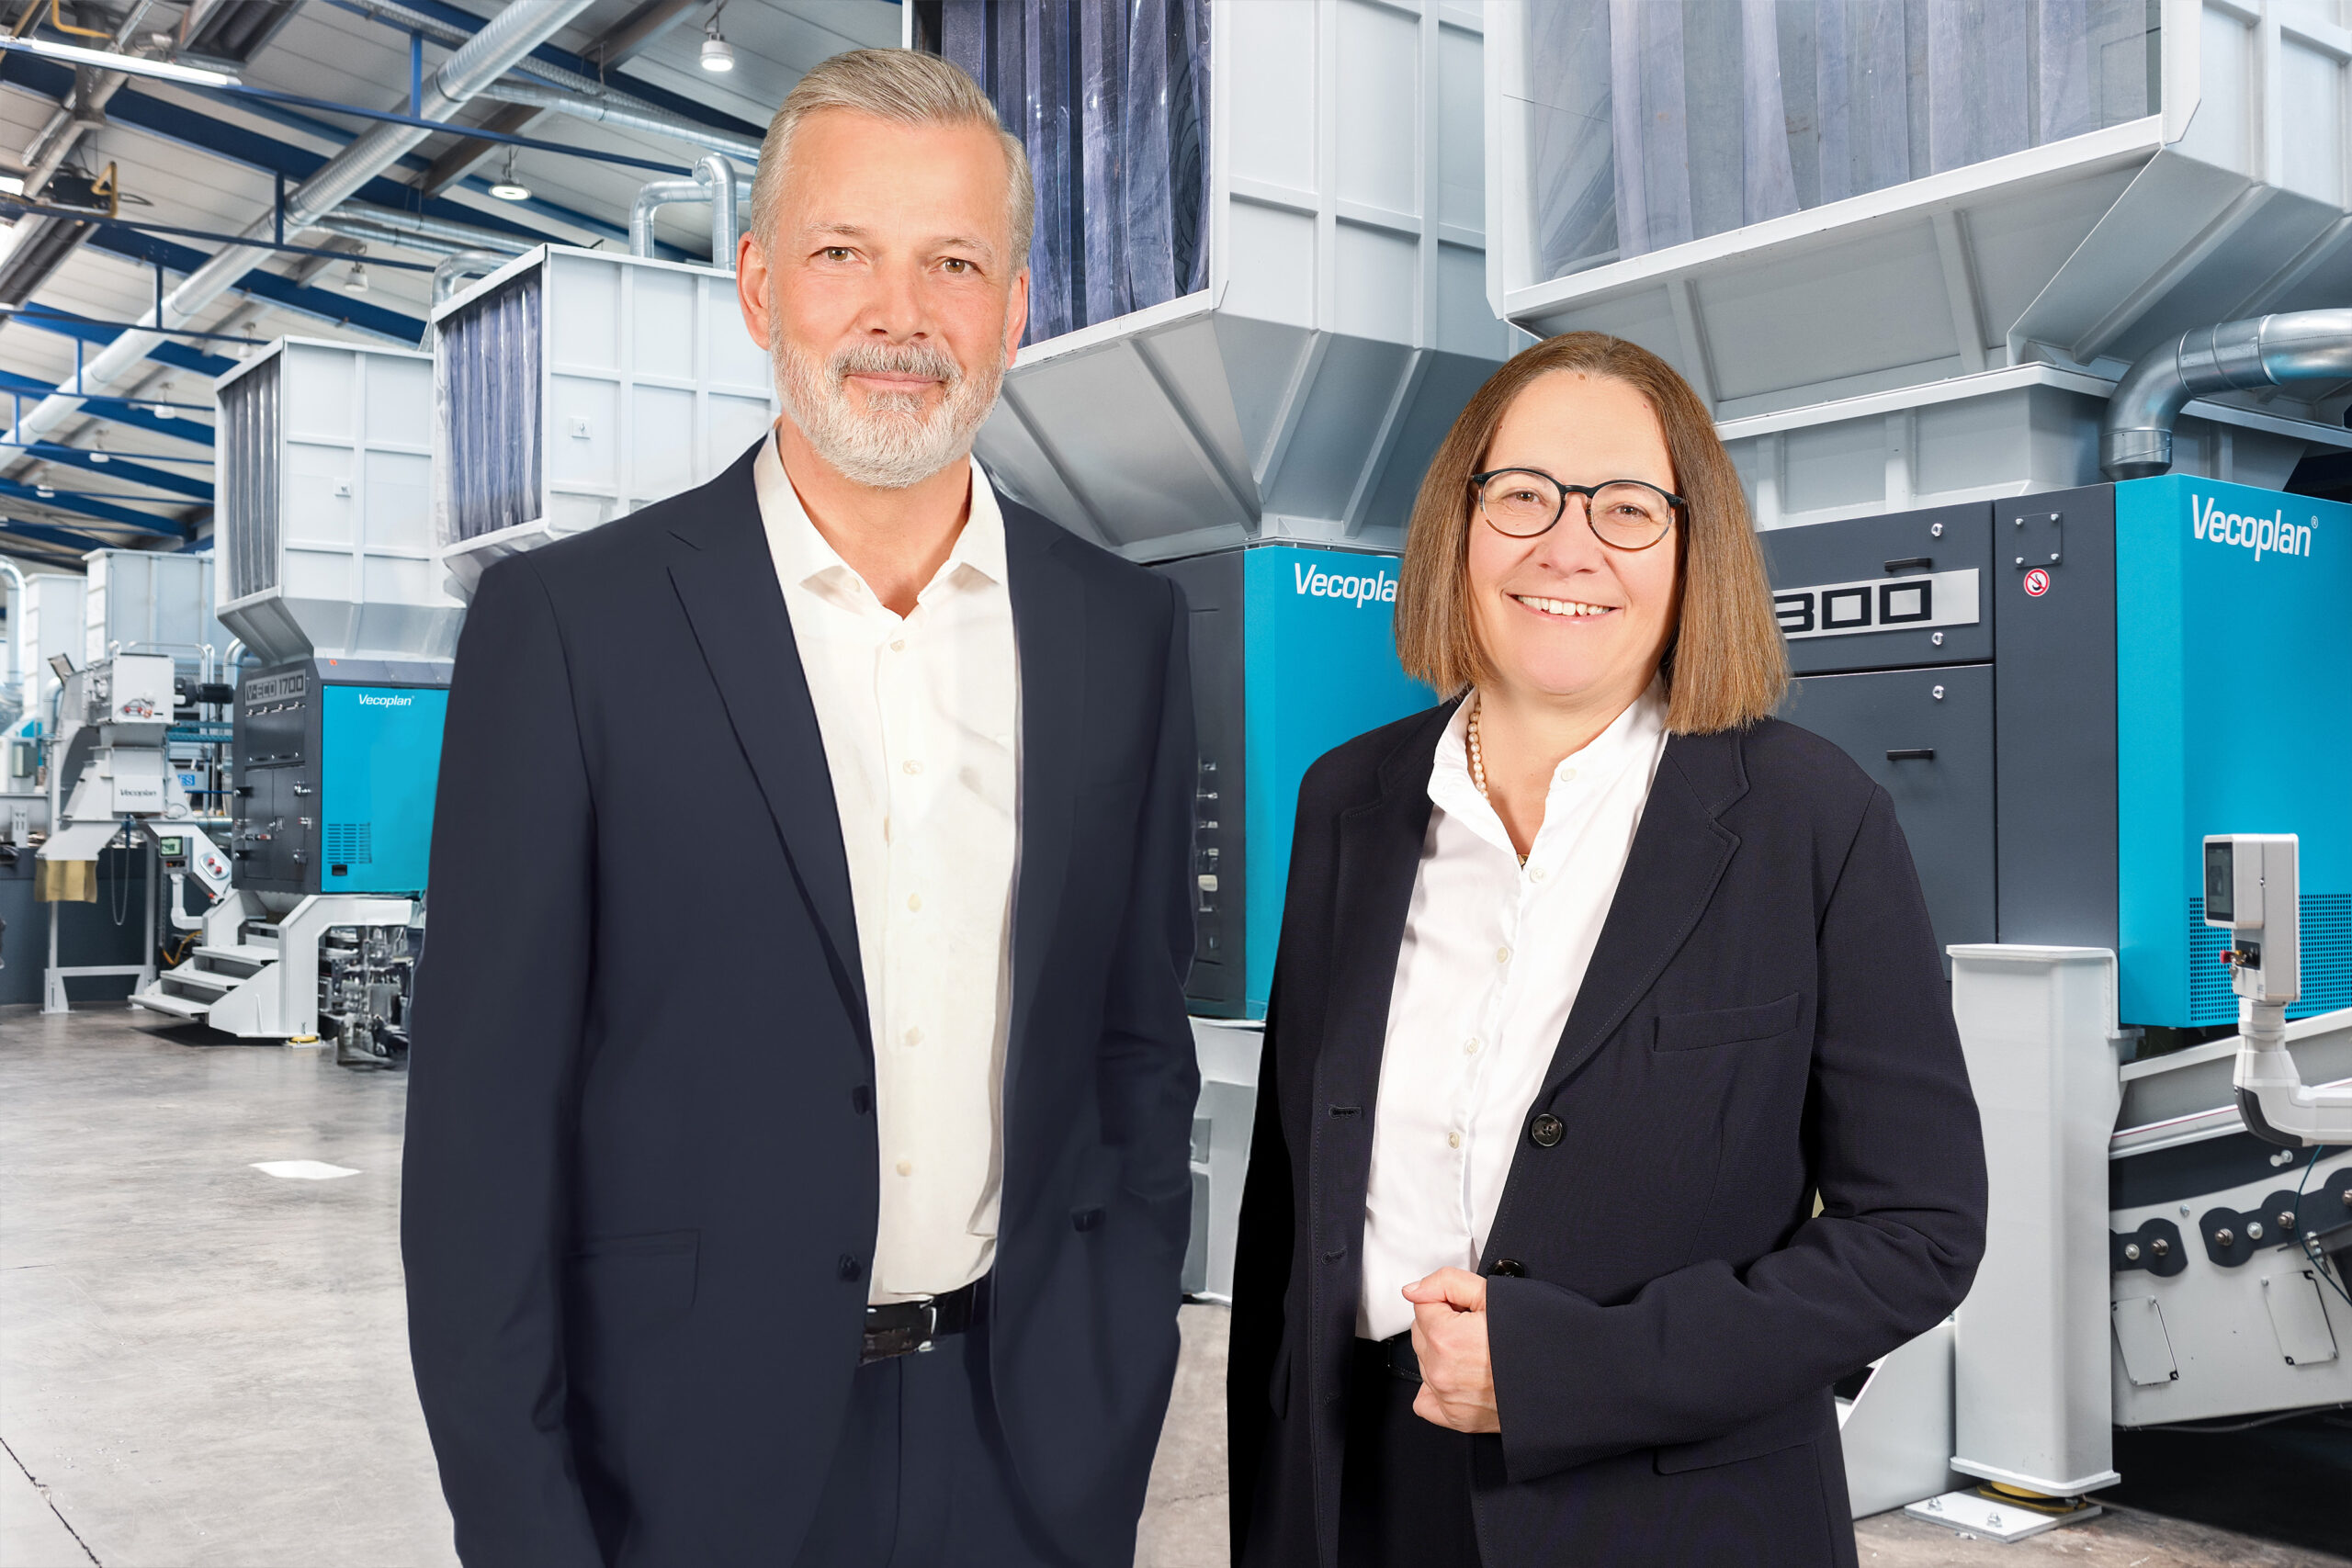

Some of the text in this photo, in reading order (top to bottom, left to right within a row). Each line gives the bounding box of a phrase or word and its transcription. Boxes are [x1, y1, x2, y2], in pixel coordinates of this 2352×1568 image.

[1295, 562, 1398, 608] Vecopla
[278, 674, 303, 695] 1700
[358, 694, 412, 708] Vecoplan
